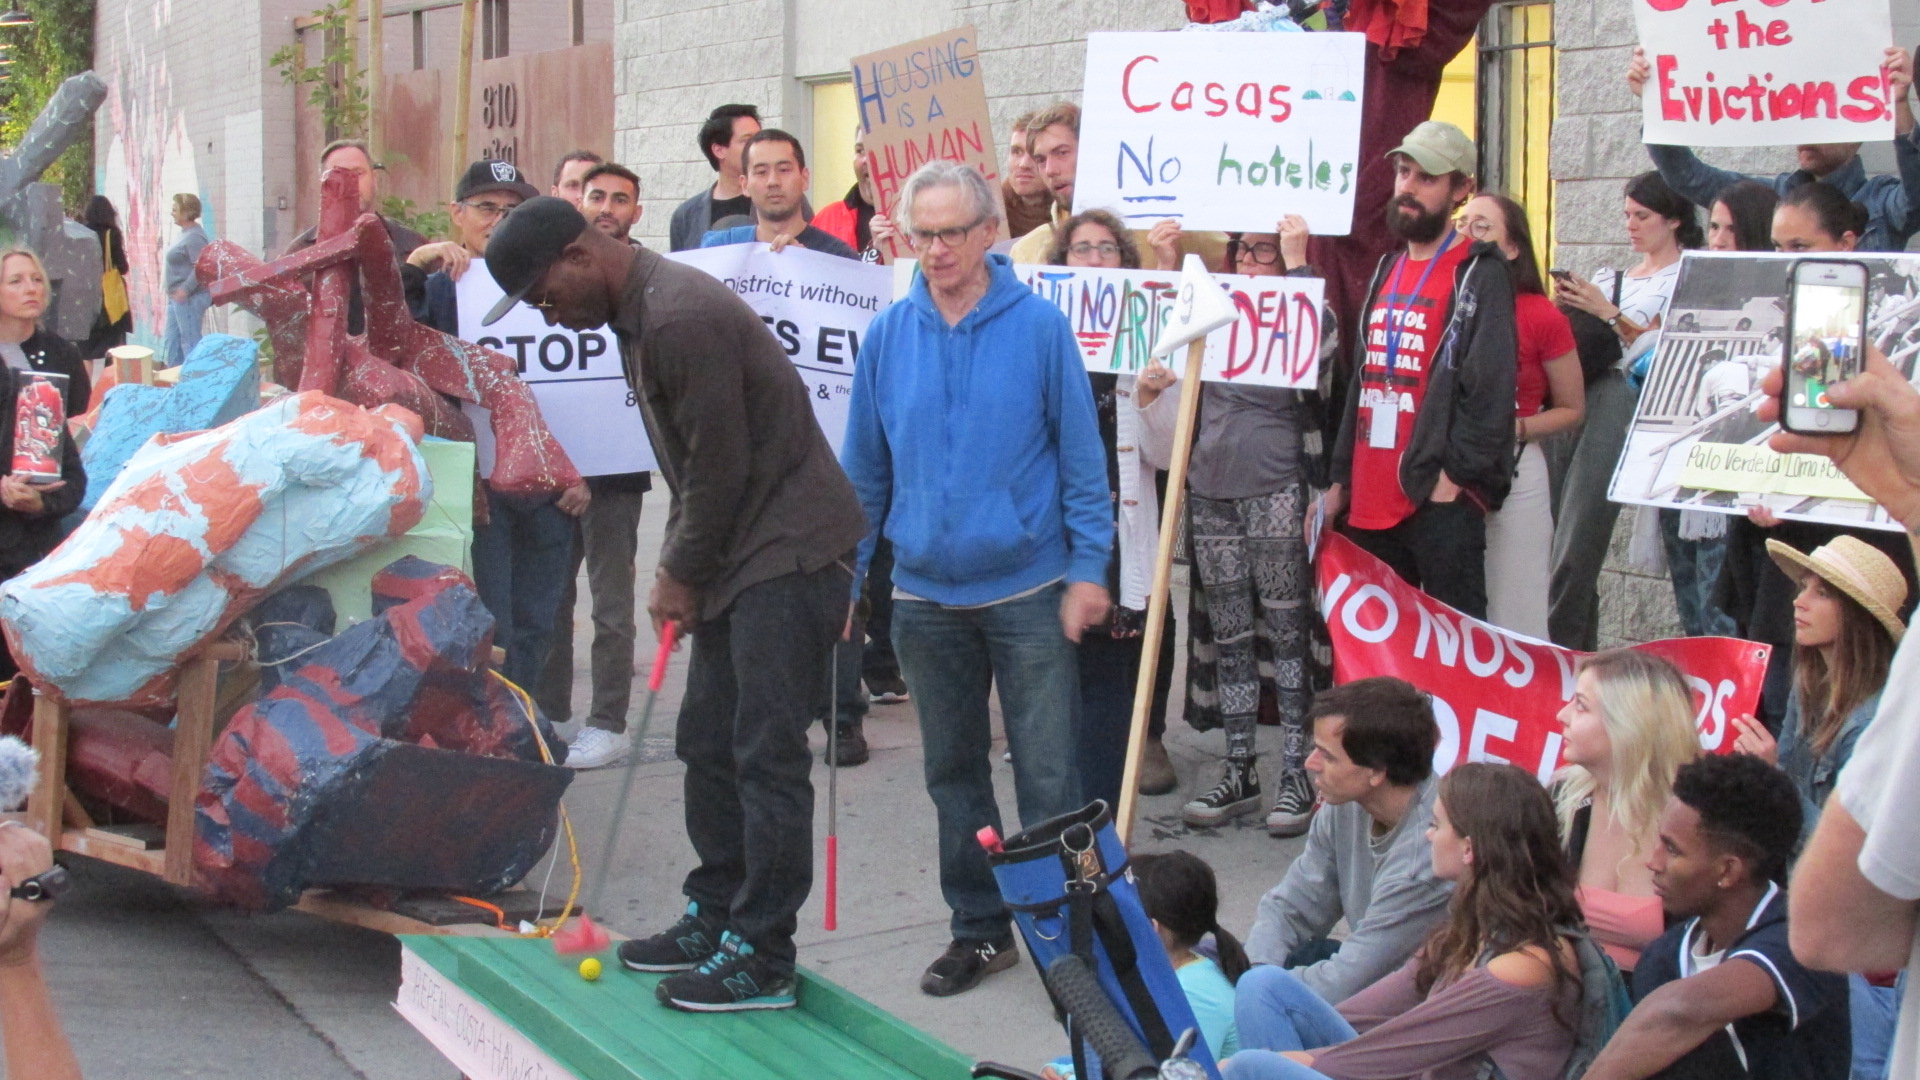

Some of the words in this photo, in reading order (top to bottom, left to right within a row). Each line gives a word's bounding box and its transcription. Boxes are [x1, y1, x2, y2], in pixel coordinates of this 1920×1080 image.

[1707, 10, 1793, 50] the
[483, 83, 518, 129] 810
[854, 37, 976, 134] HOUSING
[897, 102, 915, 128] IS
[927, 94, 945, 122] A
[1122, 55, 1293, 123] Casas
[1656, 54, 1893, 126] Evictions!
[867, 119, 984, 196] HUMAN
[1117, 134, 1182, 190] No
[1217, 137, 1353, 195] hoteles
[799, 284, 878, 312] without
[1180, 282, 1194, 326] 9
[1079, 276, 1117, 332] NO
[1220, 290, 1319, 383] DEAD
[817, 383, 831, 400] &
[1686, 444, 1721, 472] Palo
[1413, 601, 1535, 688] NOS
